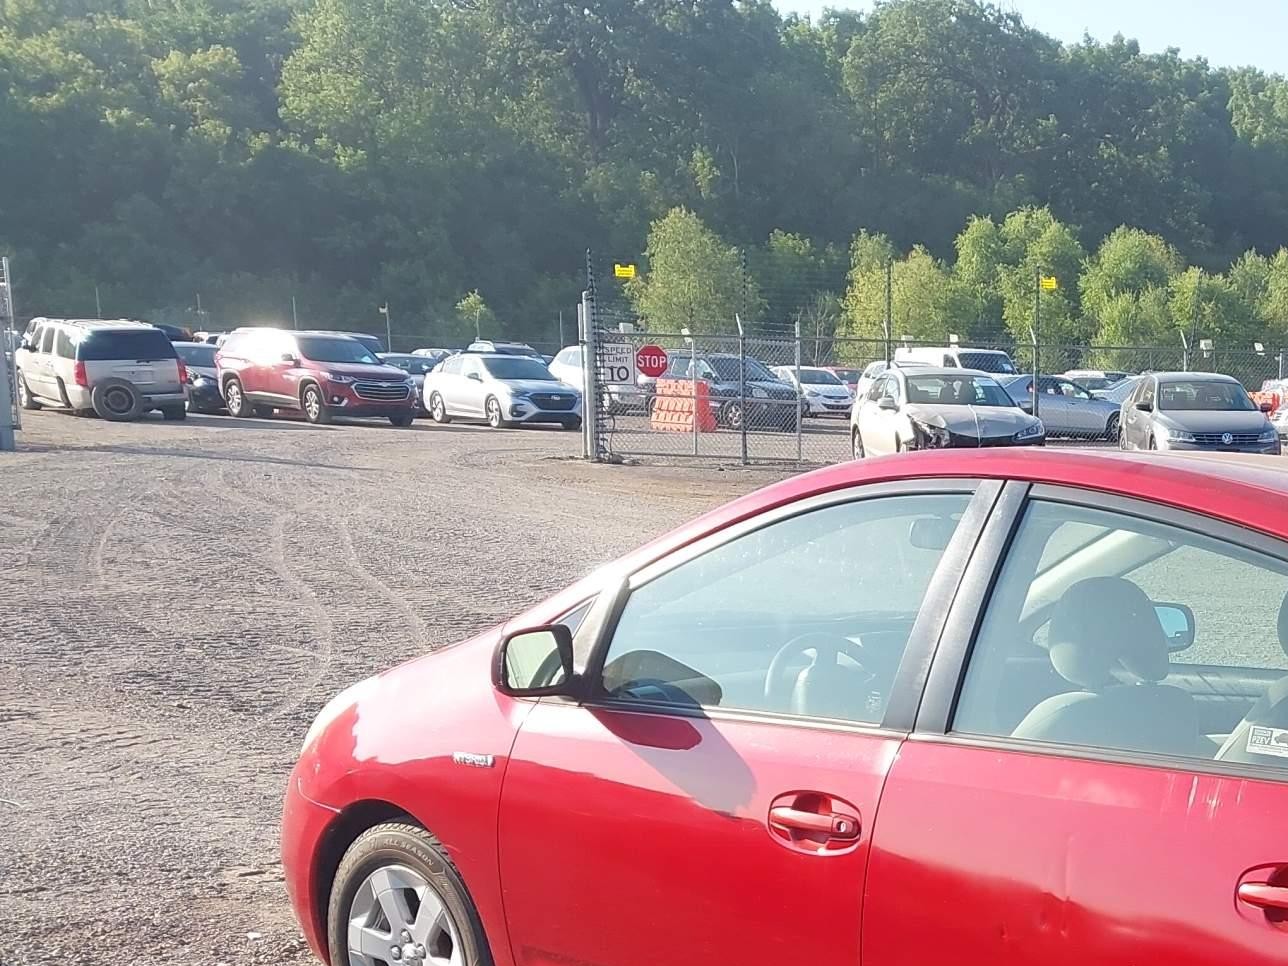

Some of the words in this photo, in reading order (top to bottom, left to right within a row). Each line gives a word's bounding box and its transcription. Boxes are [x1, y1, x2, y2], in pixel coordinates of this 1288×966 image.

[605, 346, 632, 354] SPEED
[638, 355, 666, 368] STOP
[609, 366, 629, 381] 10
